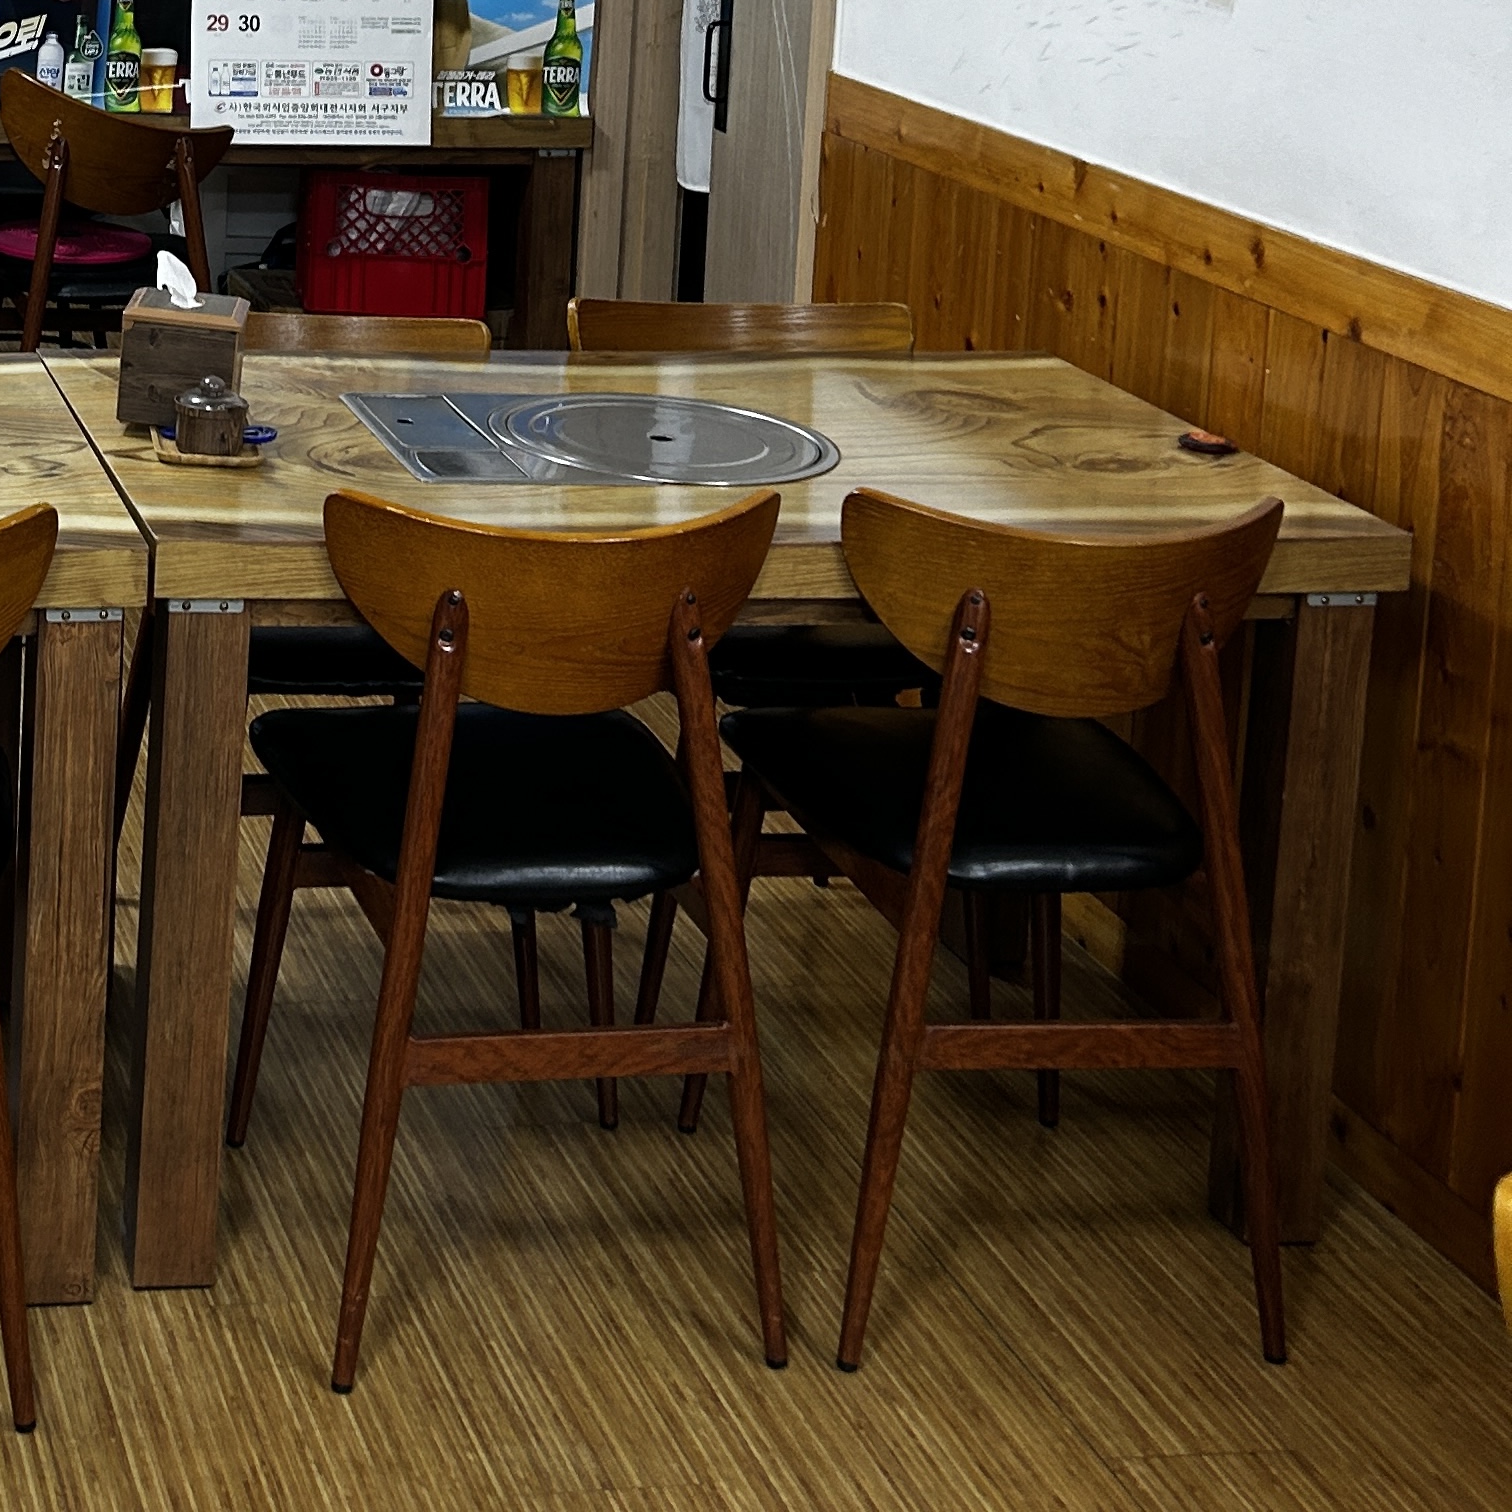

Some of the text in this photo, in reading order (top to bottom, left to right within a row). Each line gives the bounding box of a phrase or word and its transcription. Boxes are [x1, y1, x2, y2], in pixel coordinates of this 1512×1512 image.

[206, 14, 260, 33] 29 30
[543, 66, 579, 84] TERRA
[432, 81, 502, 110] TERRA
